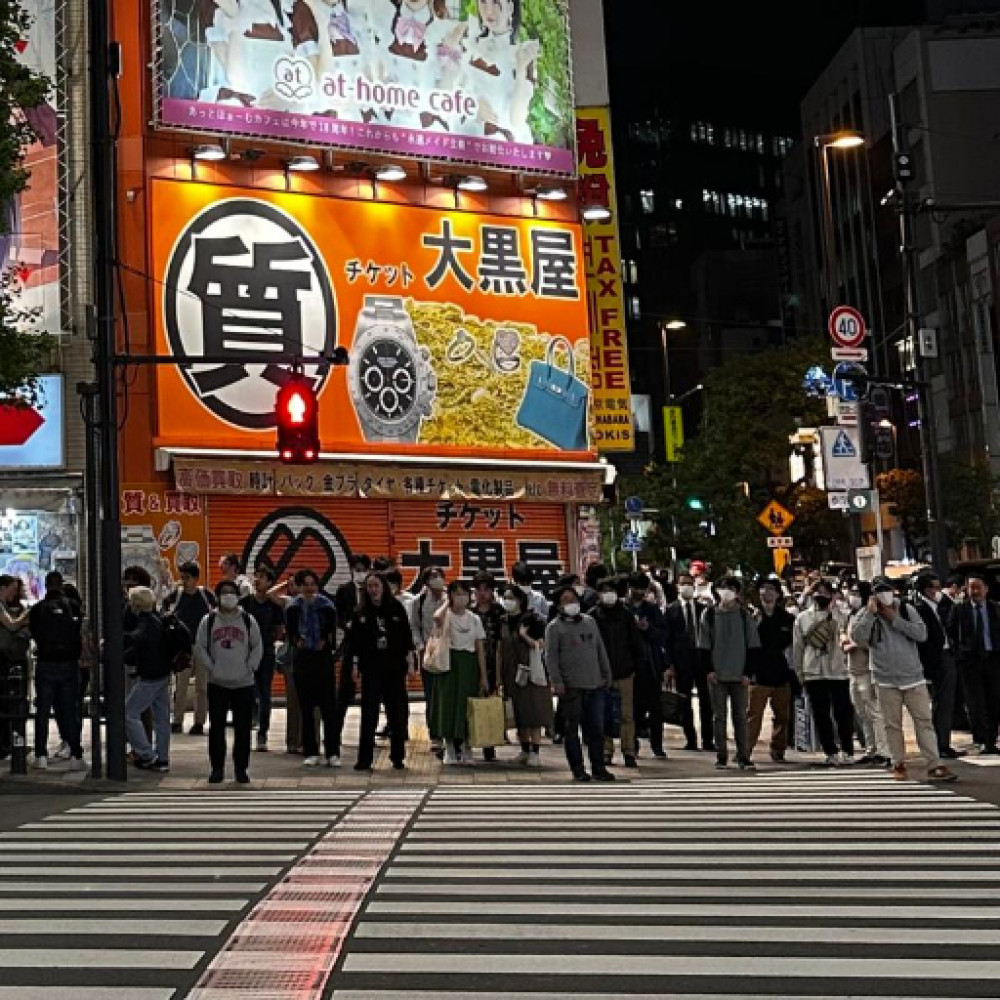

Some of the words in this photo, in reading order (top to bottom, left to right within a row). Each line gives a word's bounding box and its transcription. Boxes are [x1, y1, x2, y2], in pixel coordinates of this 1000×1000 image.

[428, 92, 477, 117] cafe
[346, 260, 414, 289] チケット
[421, 216, 581, 300] 大黒屋
[594, 235, 617, 298] TAX
[187, 235, 318, 394] 質
[839, 317, 857, 337] 40
[600, 308, 626, 390] FREE
[436, 501, 525, 530] チケット
